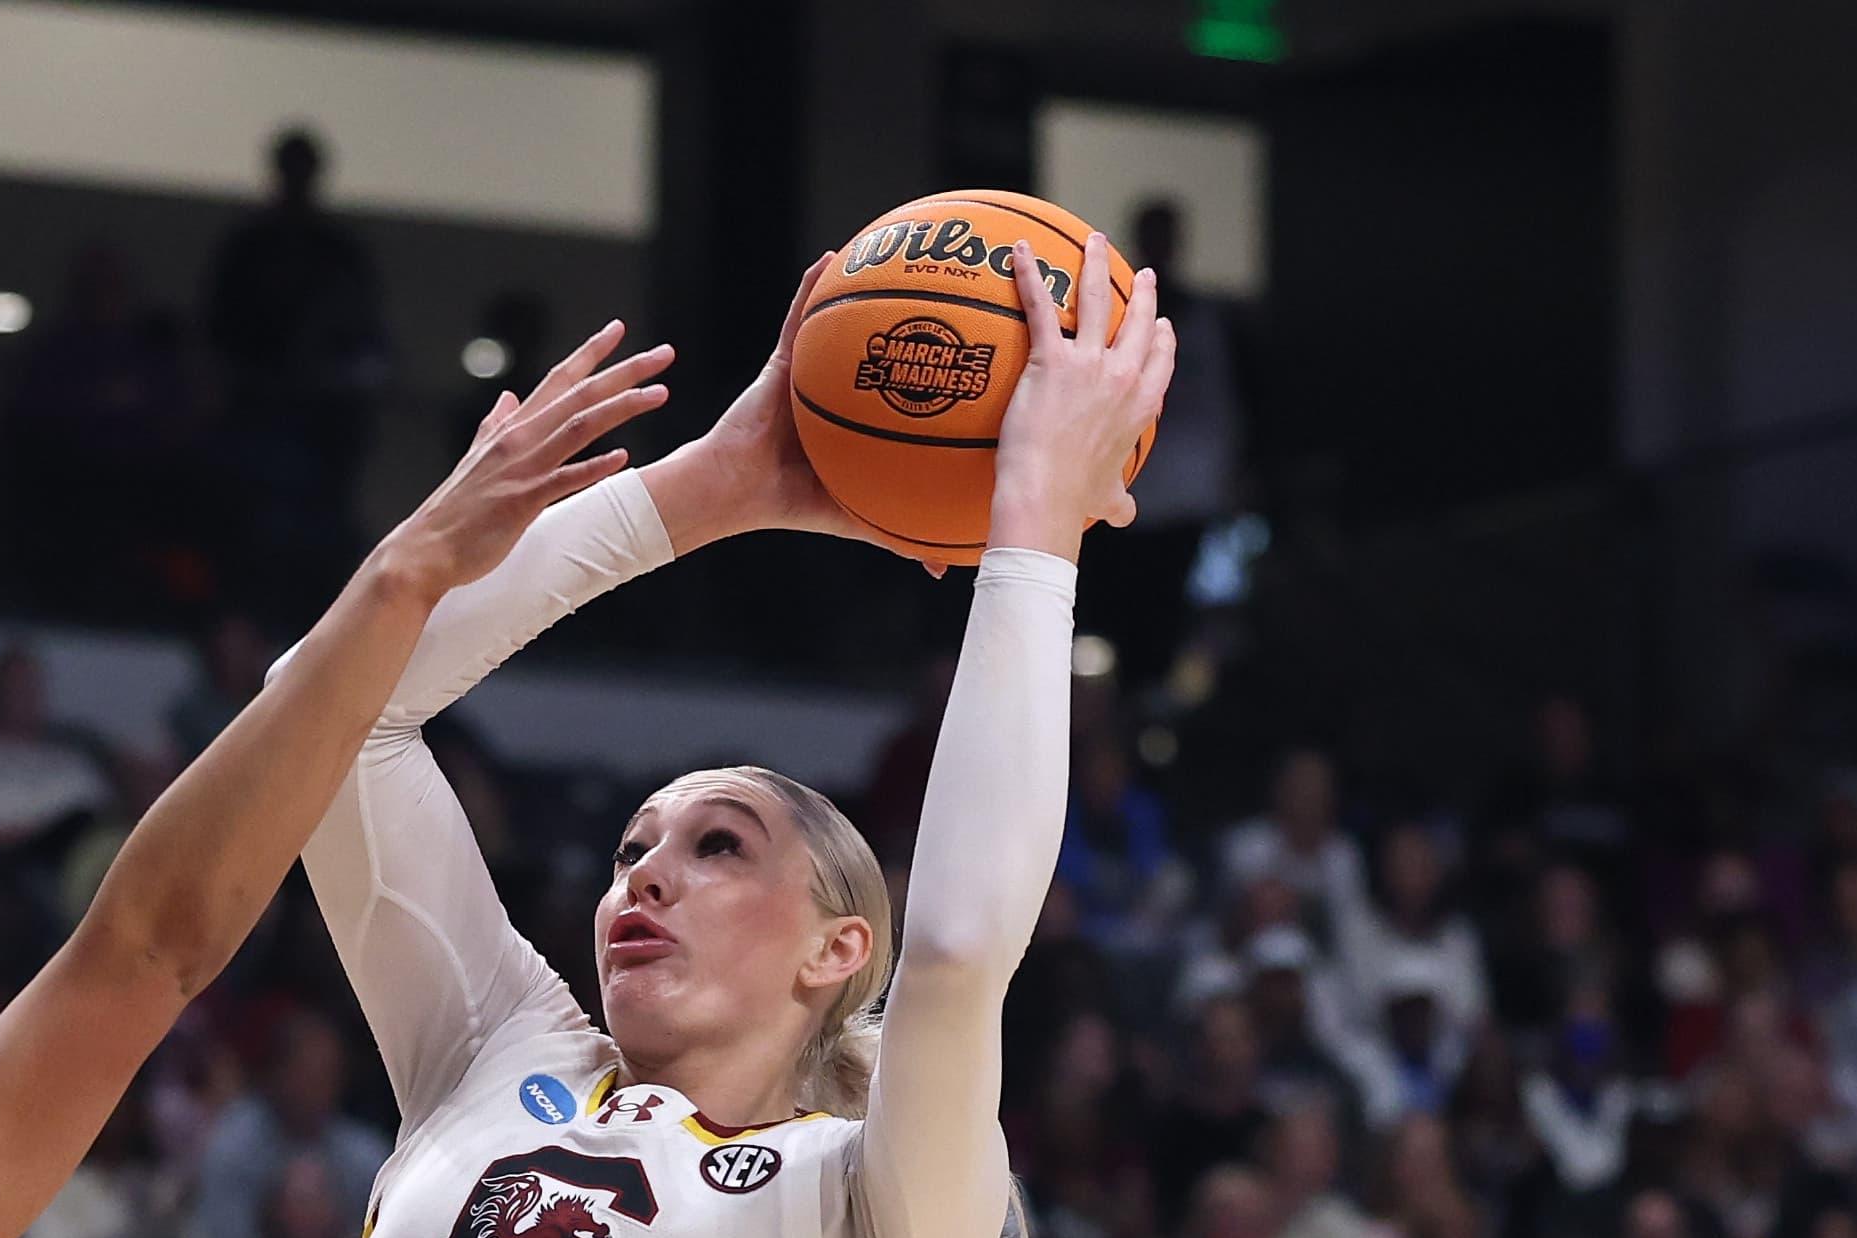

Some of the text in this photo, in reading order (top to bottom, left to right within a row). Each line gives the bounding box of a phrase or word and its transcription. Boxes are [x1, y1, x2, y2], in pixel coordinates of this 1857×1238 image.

[843, 218, 1073, 311] Wilson
[903, 264, 982, 282] EVO NXT
[886, 339, 957, 367] MARCH
[889, 361, 988, 394] MADNESS
[525, 1082, 564, 1123] NCAA
[706, 1145, 777, 1188] SEC
